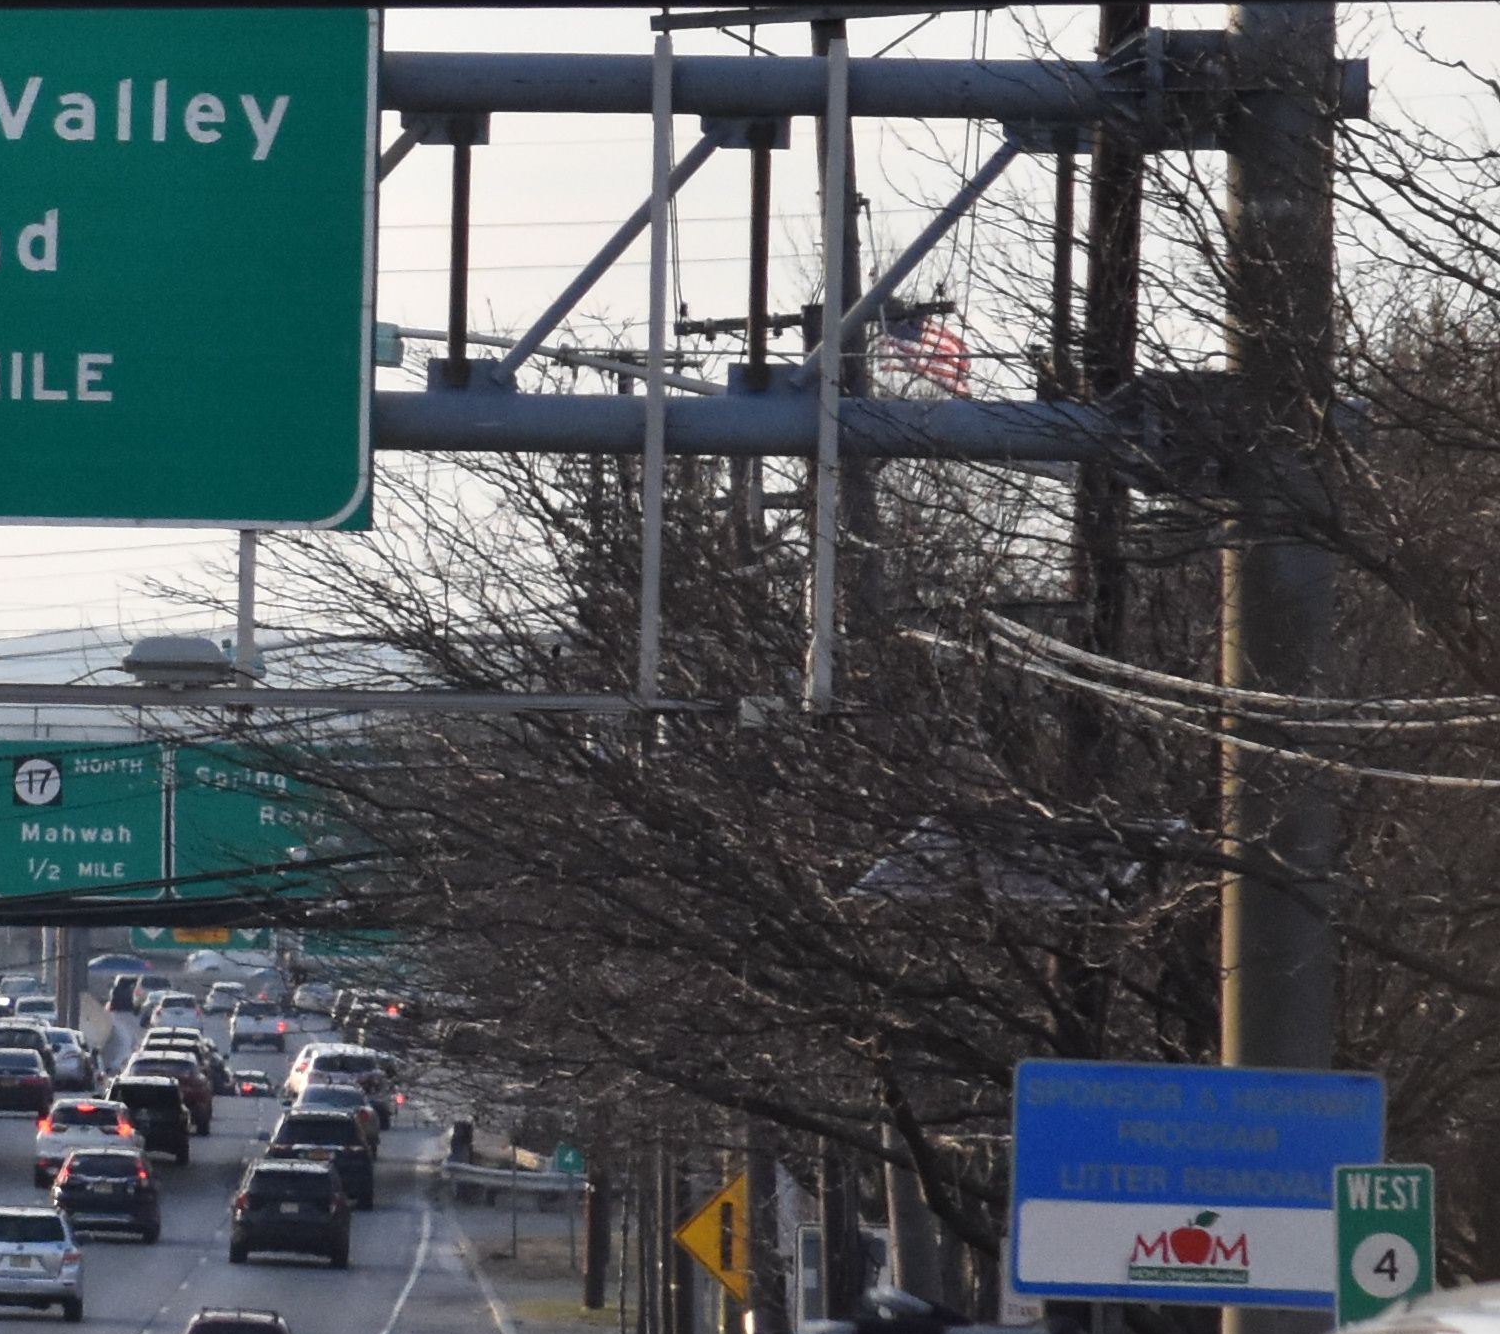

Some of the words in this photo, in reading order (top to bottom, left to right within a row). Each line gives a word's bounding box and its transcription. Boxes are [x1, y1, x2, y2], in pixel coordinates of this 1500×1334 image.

[27, 768, 53, 795] 17
[75, 758, 143, 774] NORTH
[21, 822, 132, 843] Mahwah
[28, 857, 61, 880] 1/2
[78, 862, 126, 878] MILE
[1347, 1173, 1421, 1211] WEST
[1373, 1247, 1398, 1282] 4
